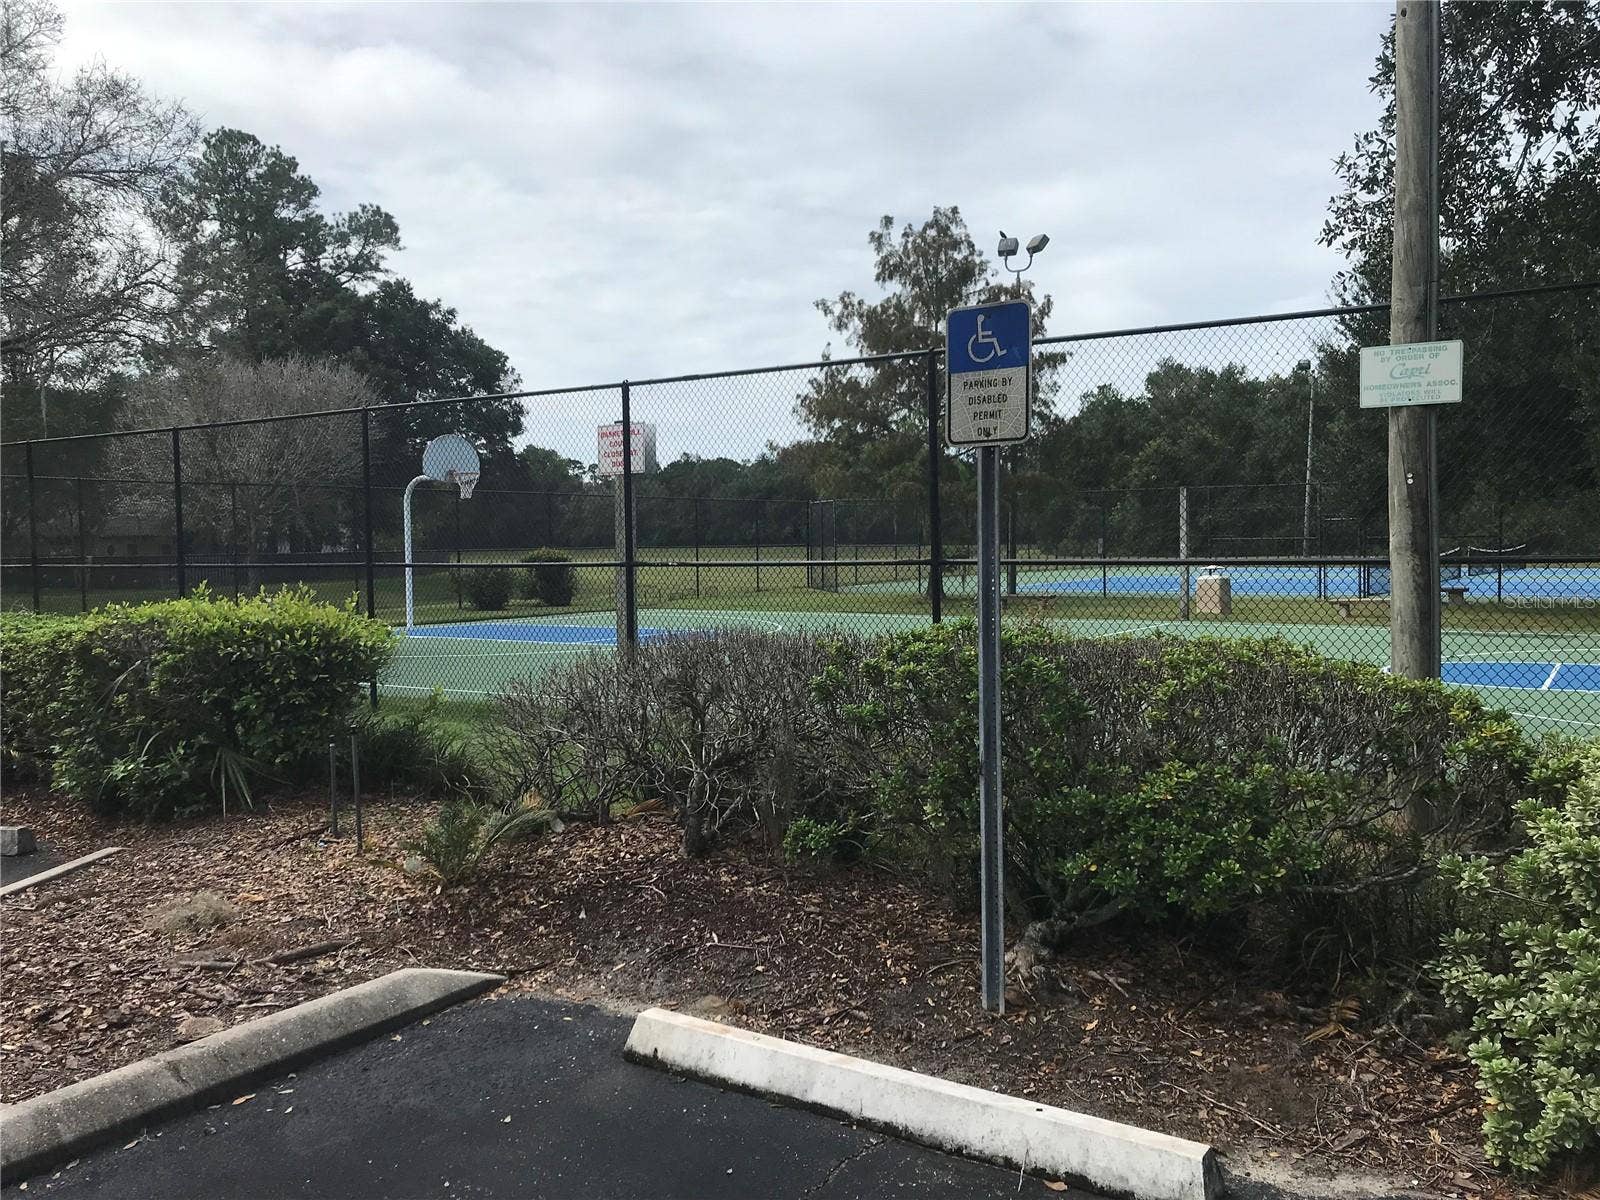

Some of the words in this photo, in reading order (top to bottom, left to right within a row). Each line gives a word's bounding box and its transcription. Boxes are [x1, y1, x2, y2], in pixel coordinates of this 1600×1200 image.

[1390, 345, 1447, 355] TRESPASSING
[963, 378, 998, 390] PARKING
[1002, 376, 1012, 386] BY
[1364, 382, 1422, 392] HOMEOWNERS
[968, 394, 1008, 406] DISABLED
[973, 410, 1002, 420] PERMIT
[977, 426, 998, 436] ONLY
